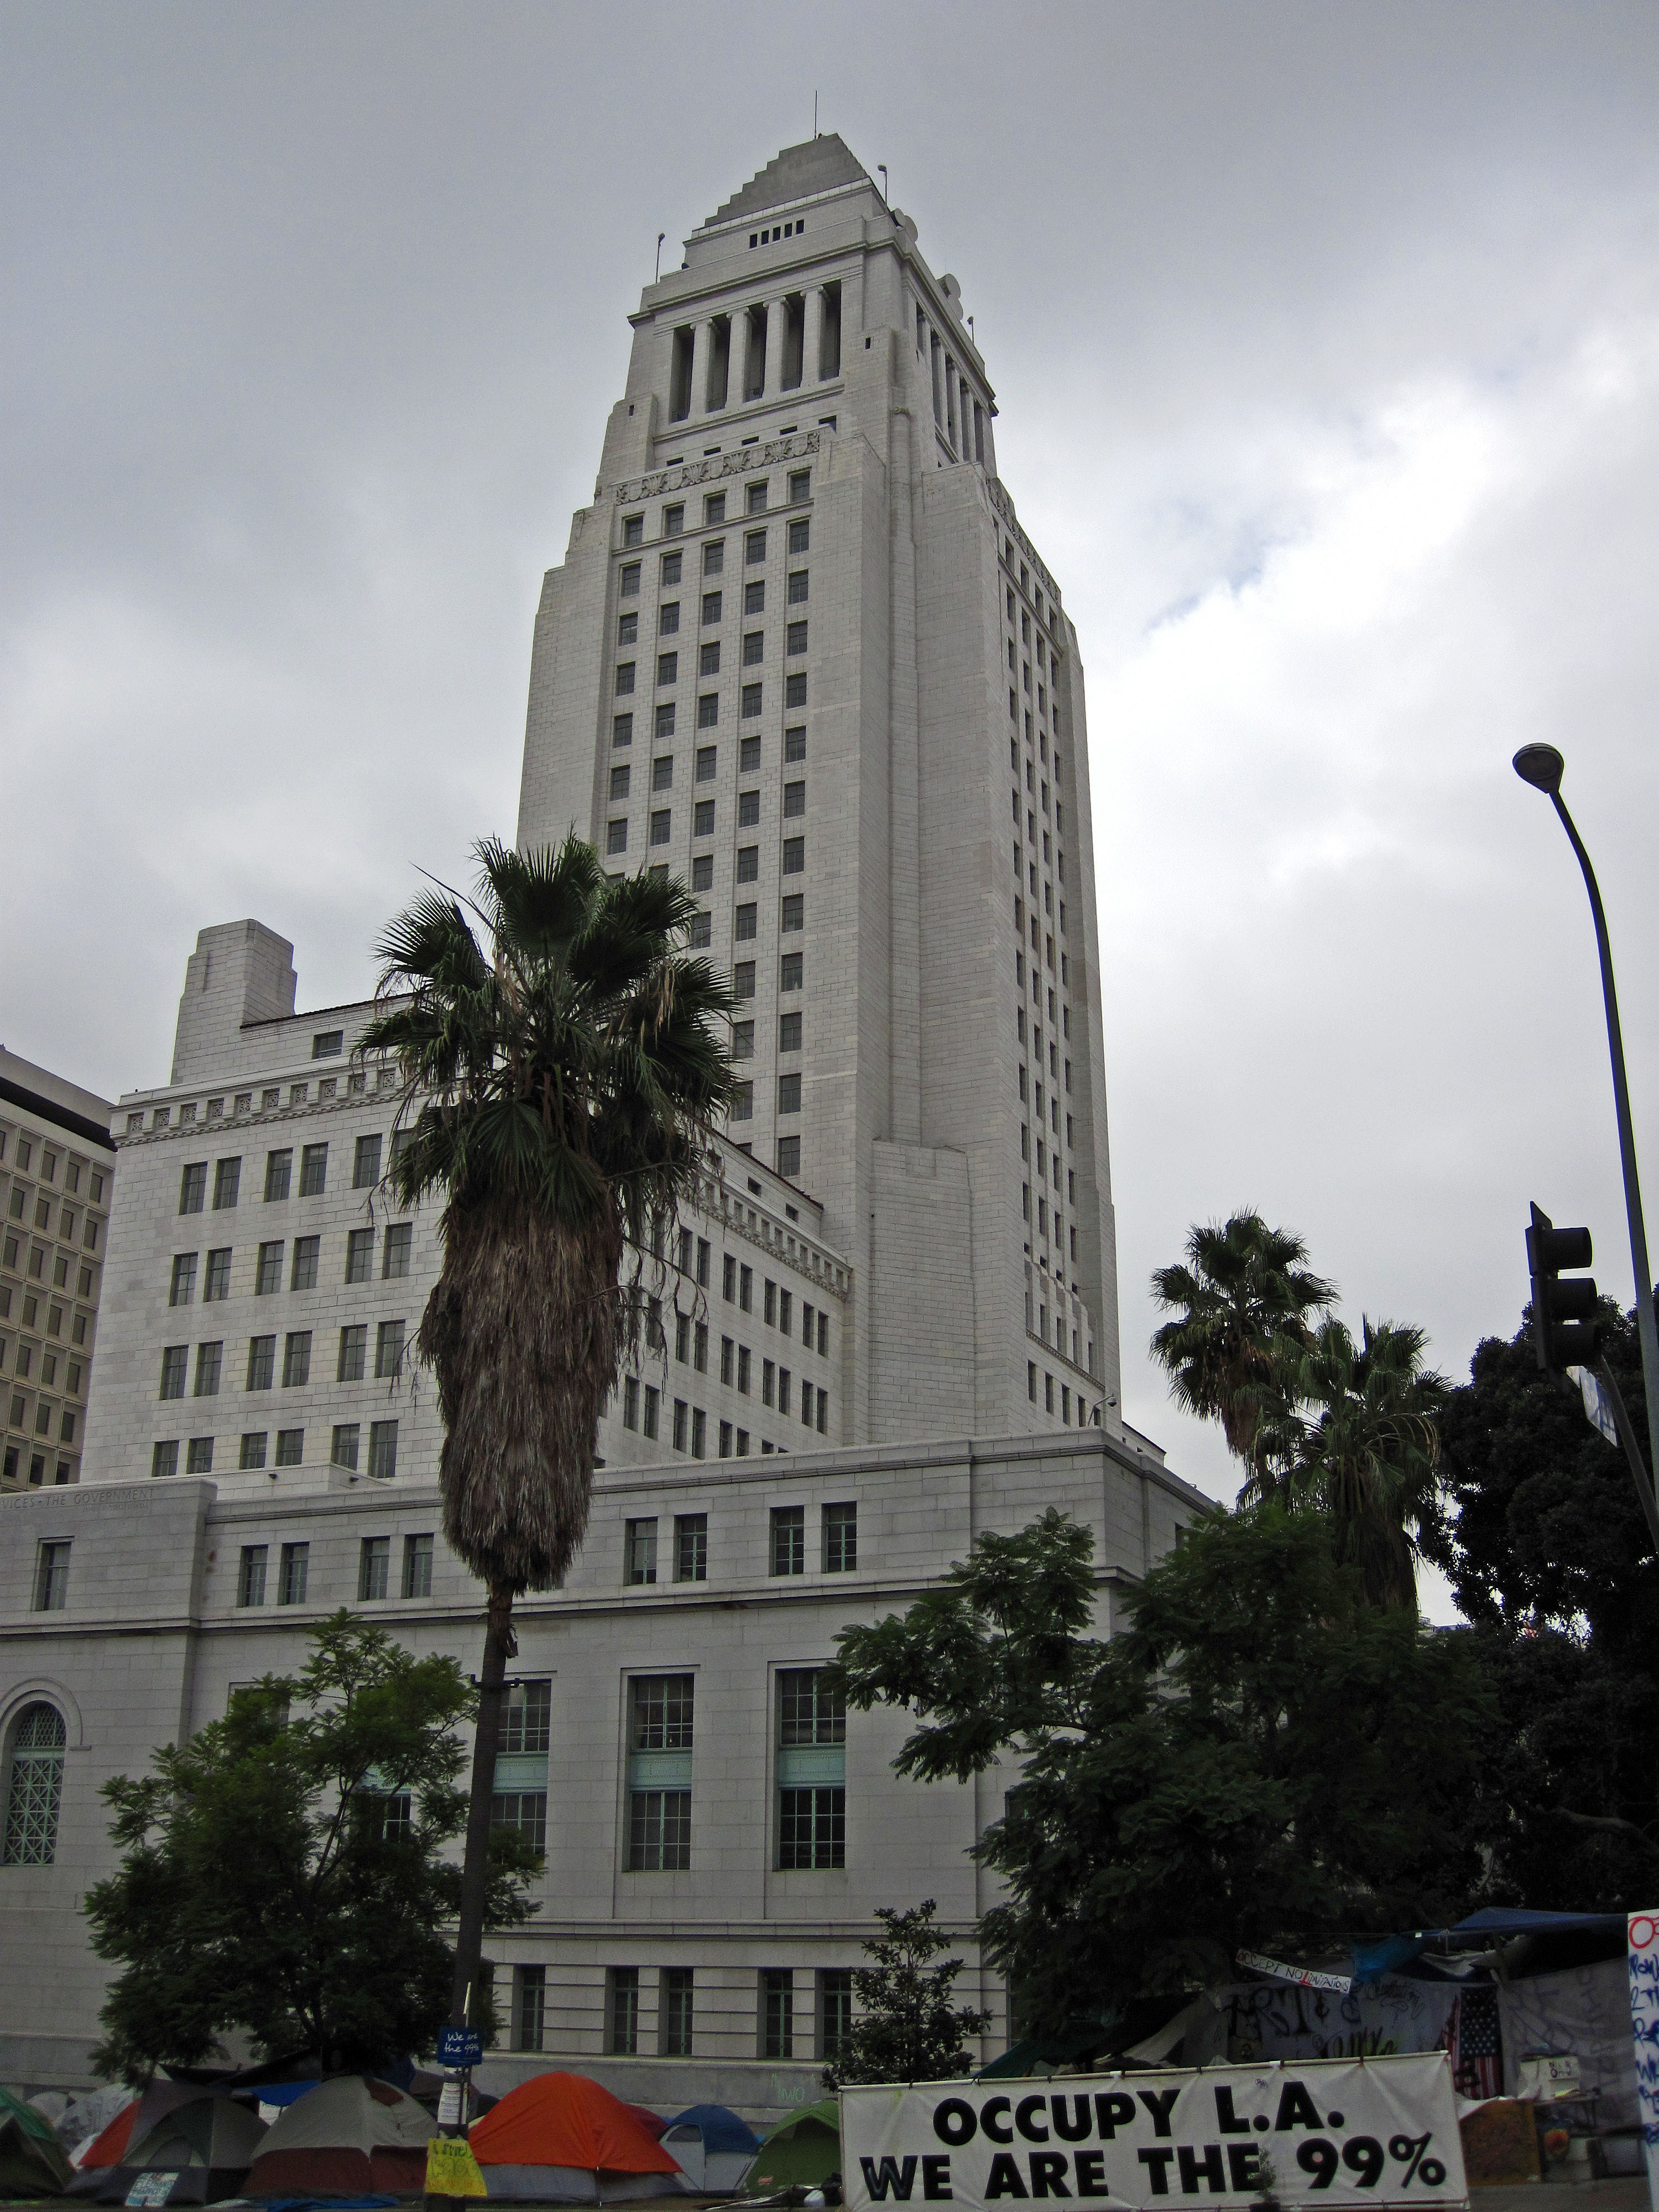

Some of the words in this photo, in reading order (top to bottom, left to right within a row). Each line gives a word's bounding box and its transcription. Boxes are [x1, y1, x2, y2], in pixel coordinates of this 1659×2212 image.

[46, 1495, 66, 1507] THE
[1235, 1952, 1282, 1973] ACCEPT
[1286, 1967, 1302, 1979] NO
[447, 2031, 464, 2041] We
[444, 2042, 462, 2052] the
[465, 2043, 479, 2054] 99%
[933, 2088, 1180, 2146] OCCUPY
[1214, 2081, 1344, 2133] L.A.
[859, 2154, 953, 2201] WE
[984, 2150, 1109, 2199] ARE
[1138, 2142, 1259, 2195] THE
[1296, 2131, 1446, 2189] 99%
